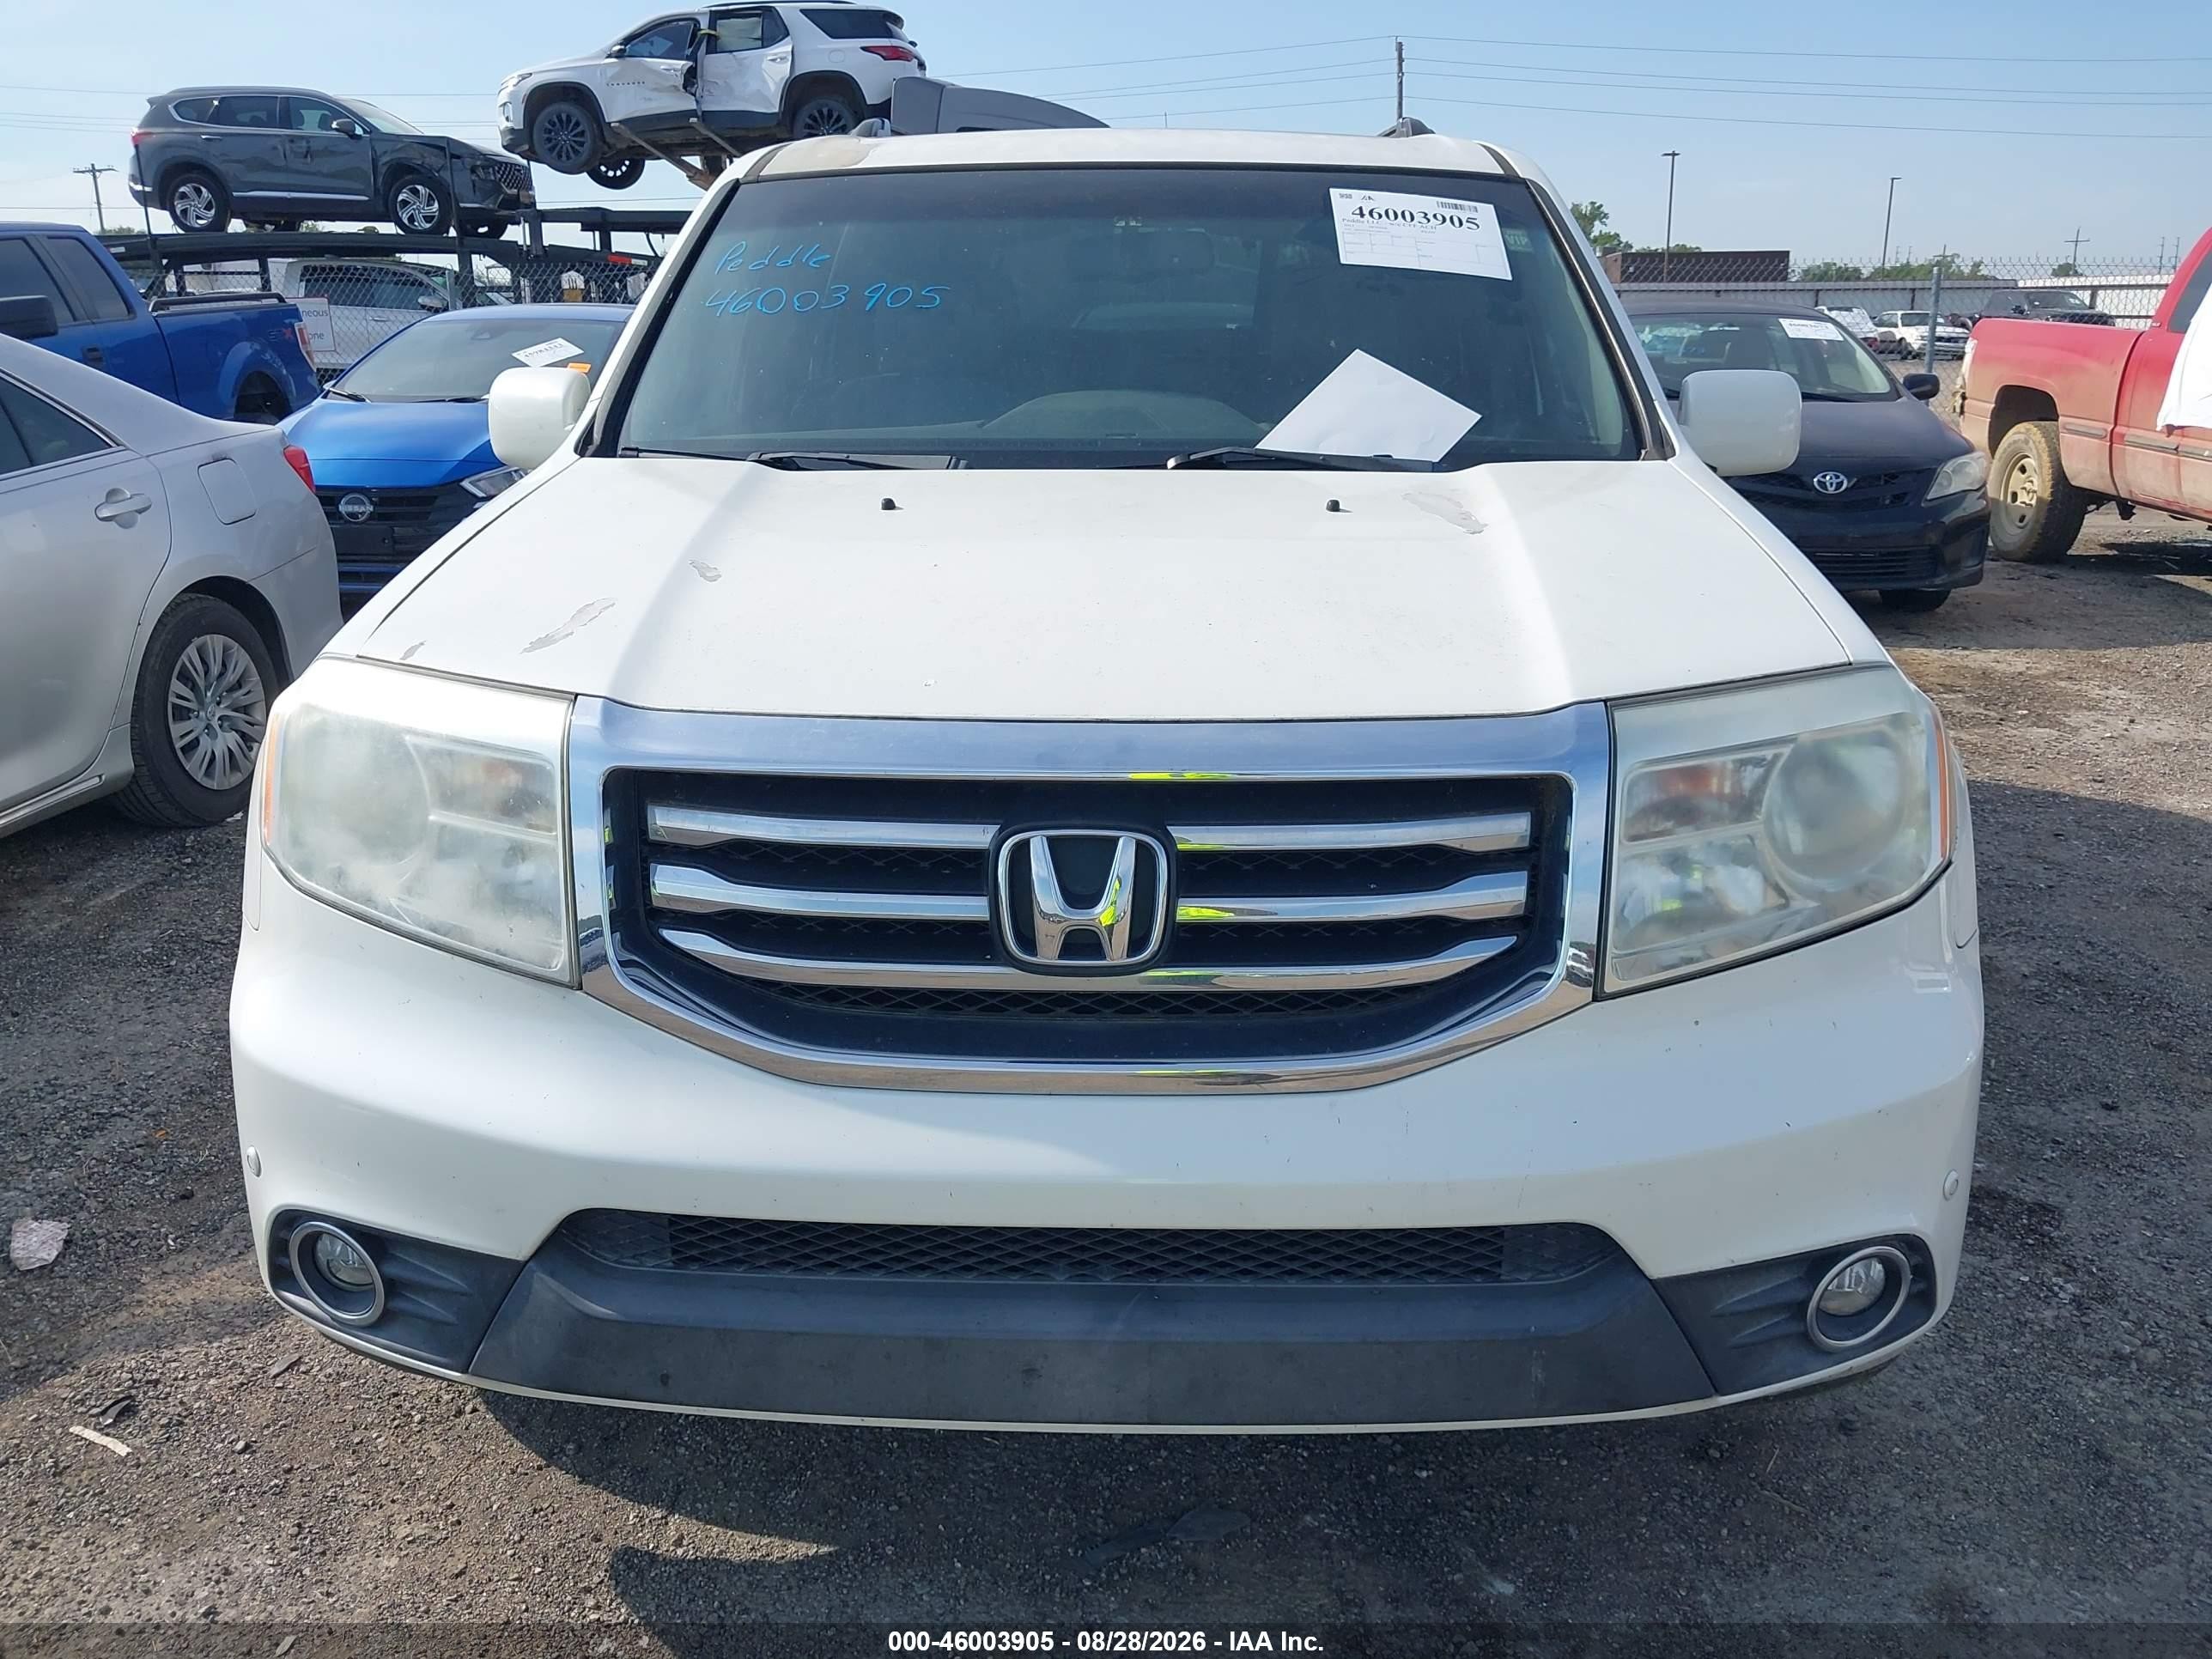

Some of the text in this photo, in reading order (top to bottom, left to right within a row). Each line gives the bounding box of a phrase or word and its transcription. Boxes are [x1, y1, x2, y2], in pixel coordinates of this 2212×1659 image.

[1352, 205, 1480, 231] 46003905
[714, 241, 831, 275] Peddle
[309, 331, 325, 340] one
